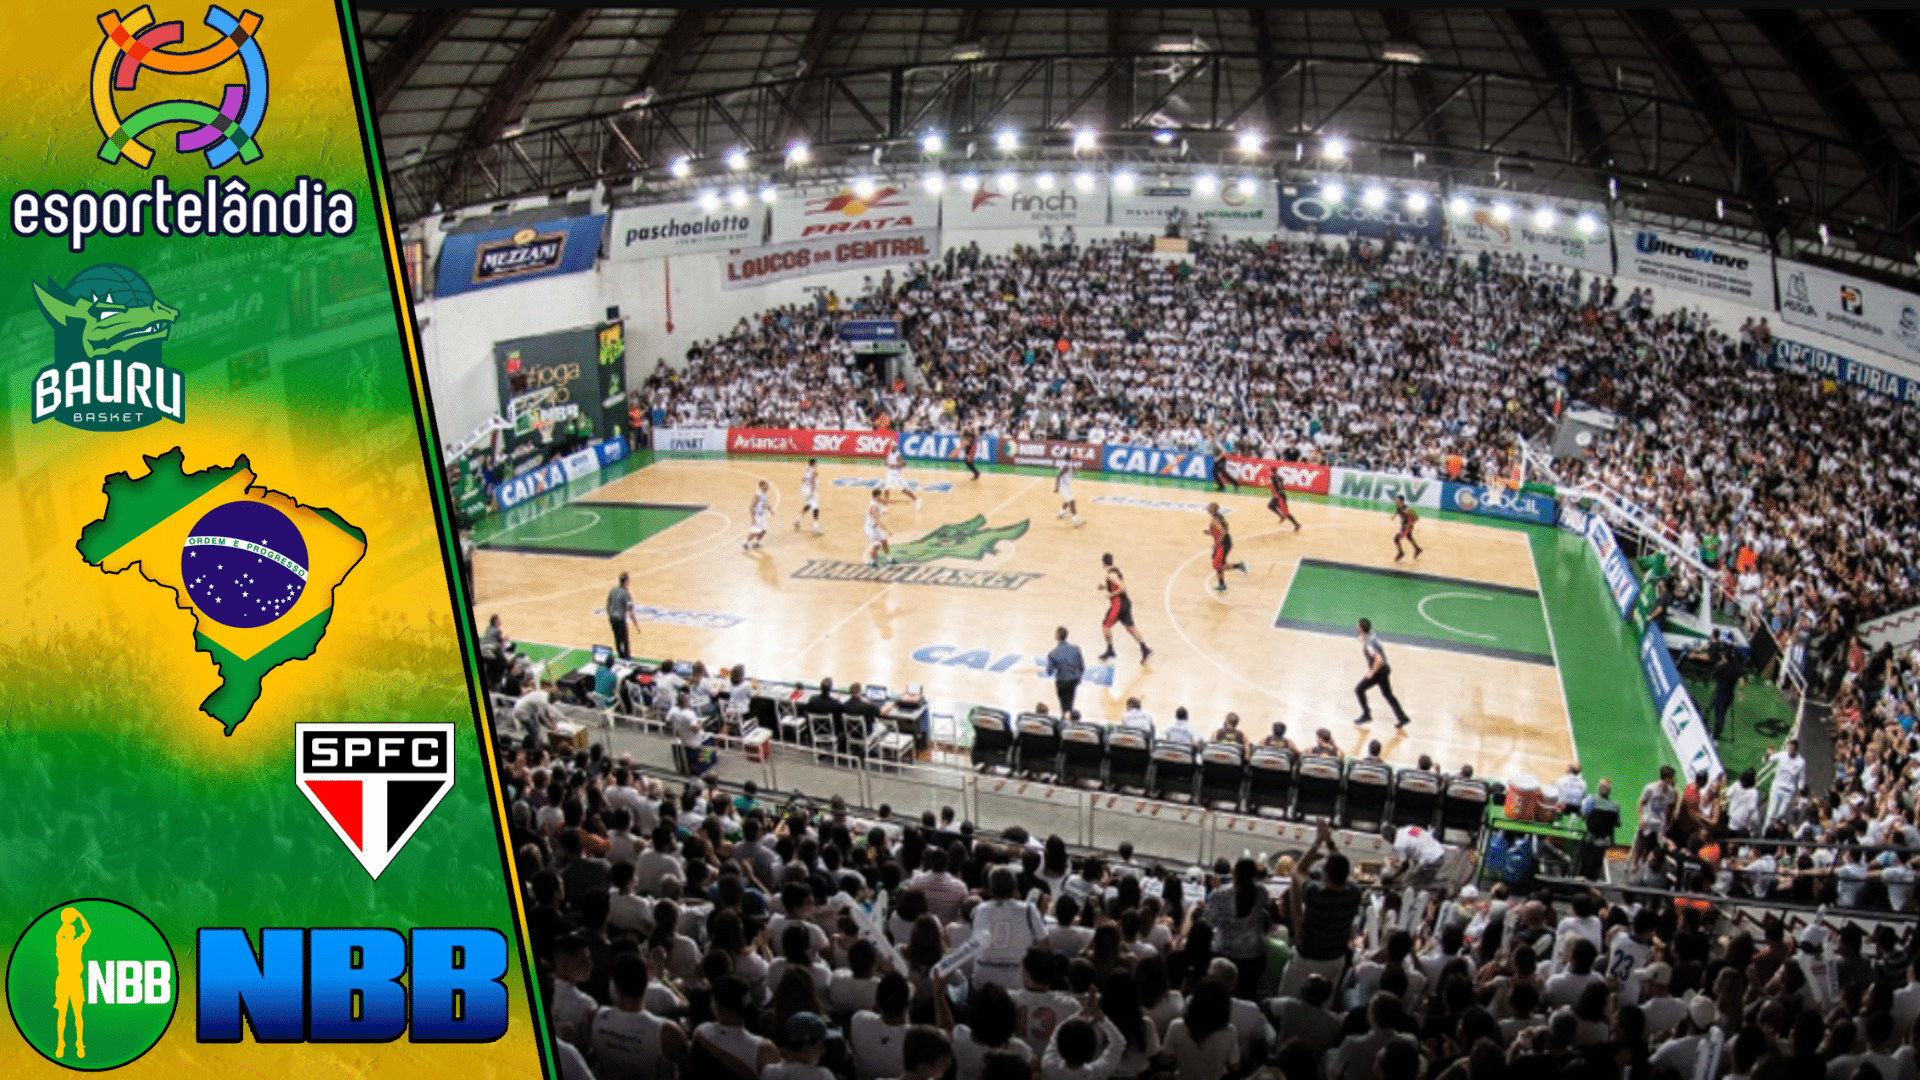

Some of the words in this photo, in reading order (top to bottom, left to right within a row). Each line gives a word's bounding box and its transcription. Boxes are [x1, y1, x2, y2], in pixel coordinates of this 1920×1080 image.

[1011, 190, 1077, 211] finch
[625, 215, 750, 247] paschoalotto
[801, 215, 914, 237] PRATA
[482, 243, 558, 269] MEZZANI
[727, 248, 811, 282] LOUCOS
[835, 236, 931, 263] CENTRAL
[1636, 231, 1749, 270] UltraWave
[734, 434, 788, 449] Avianca
[812, 434, 848, 451] SKY
[855, 436, 890, 453] SKY
[903, 435, 990, 460] CAIXA
[1107, 449, 1206, 479] CAIXA
[1276, 465, 1320, 487] SKY
[502, 461, 564, 507] CAIXA
[1339, 472, 1430, 502] MRV
[1611, 948, 1636, 982] 23
